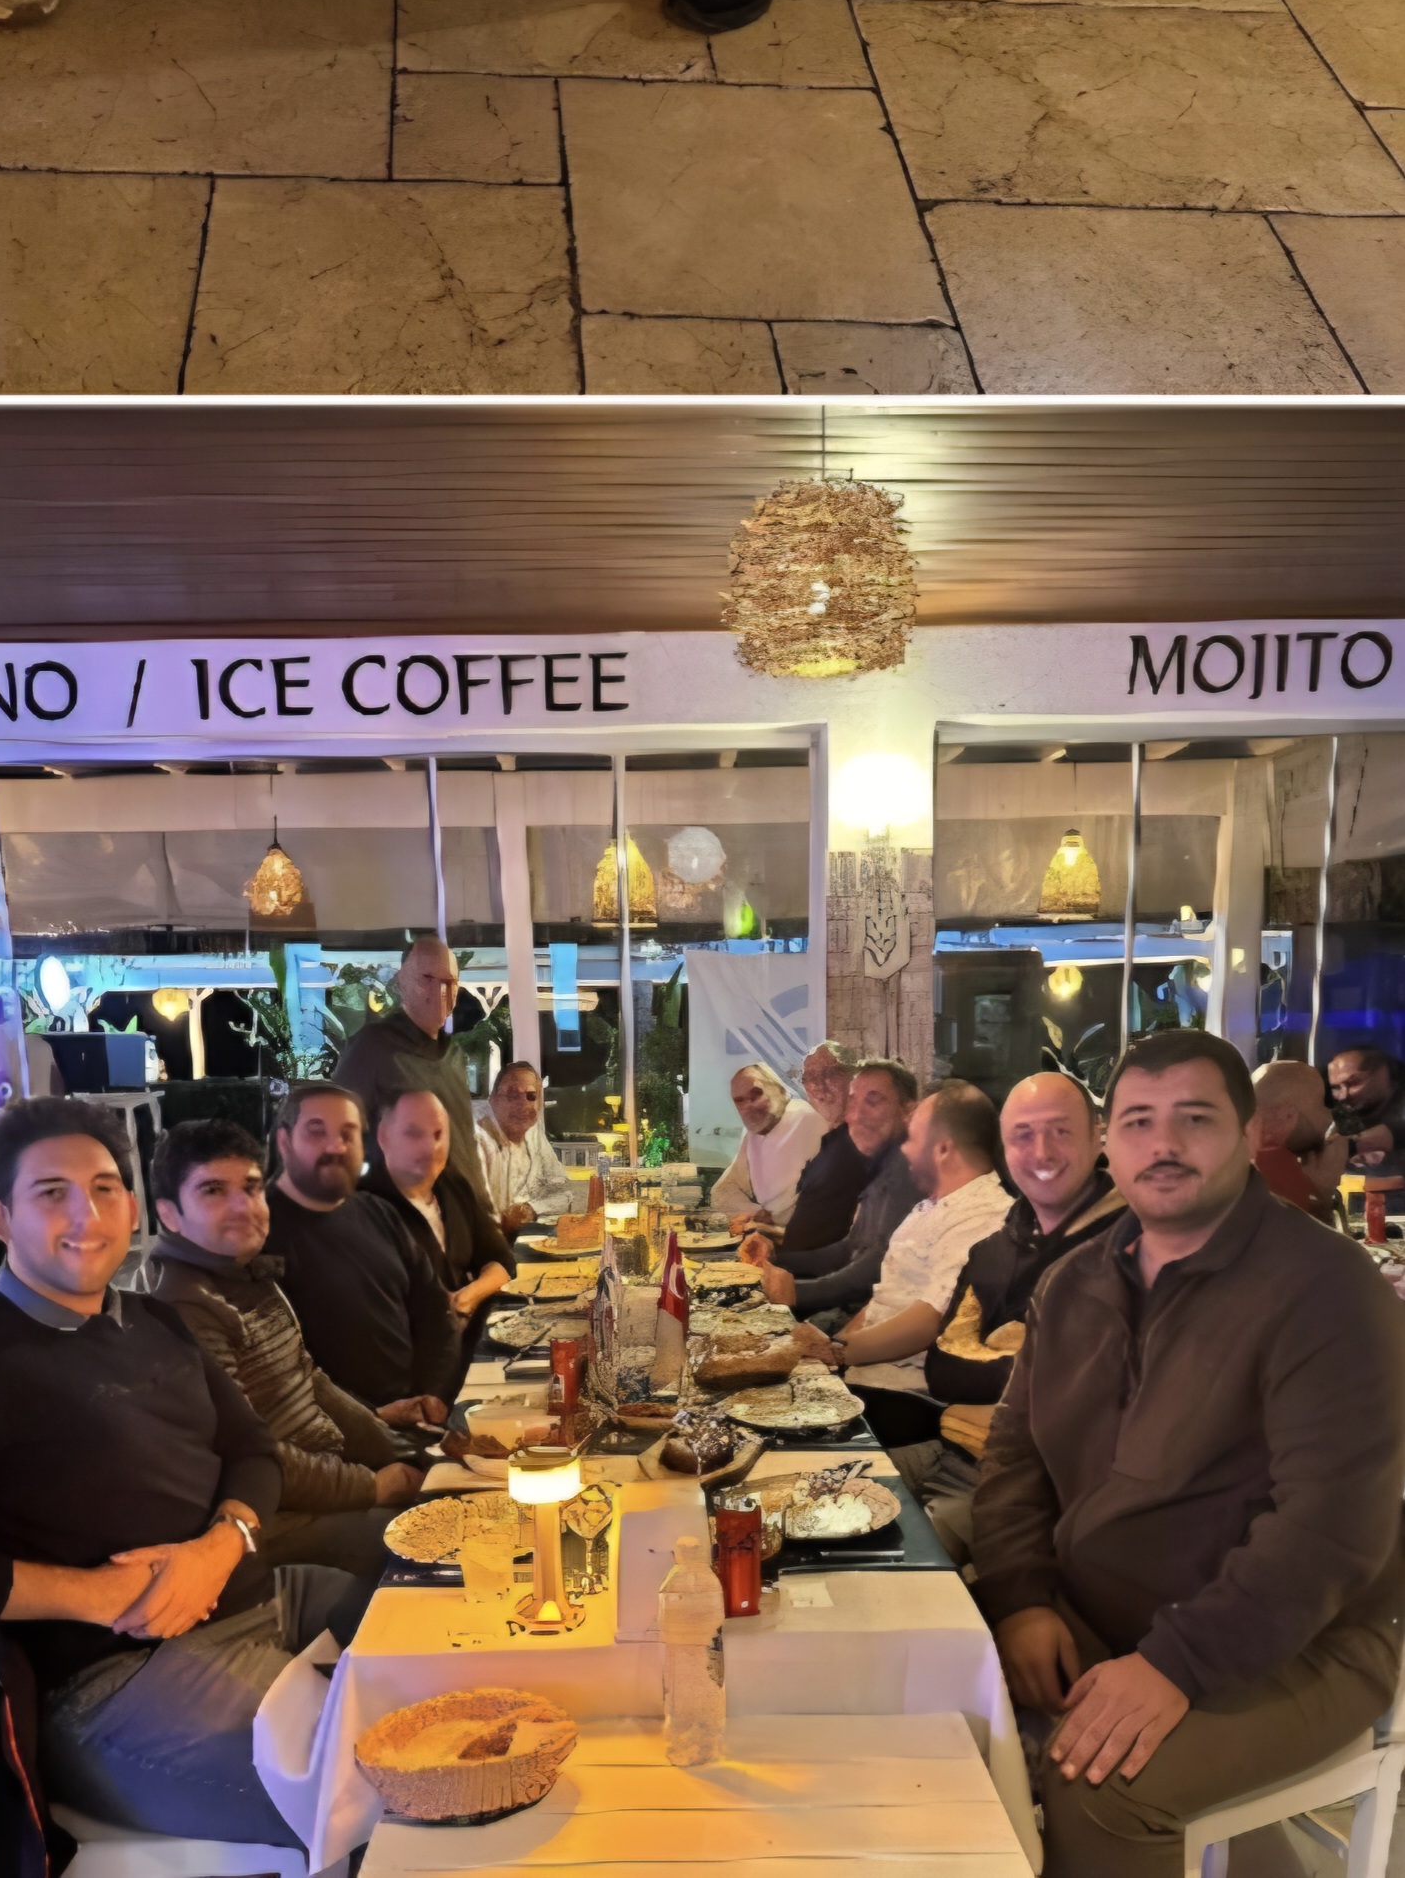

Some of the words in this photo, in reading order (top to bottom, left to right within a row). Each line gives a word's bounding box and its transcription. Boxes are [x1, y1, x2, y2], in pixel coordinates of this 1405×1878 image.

[190, 656, 314, 720] ICE
[341, 652, 630, 715] COFFEE
[1127, 631, 1394, 700] MOJITO
